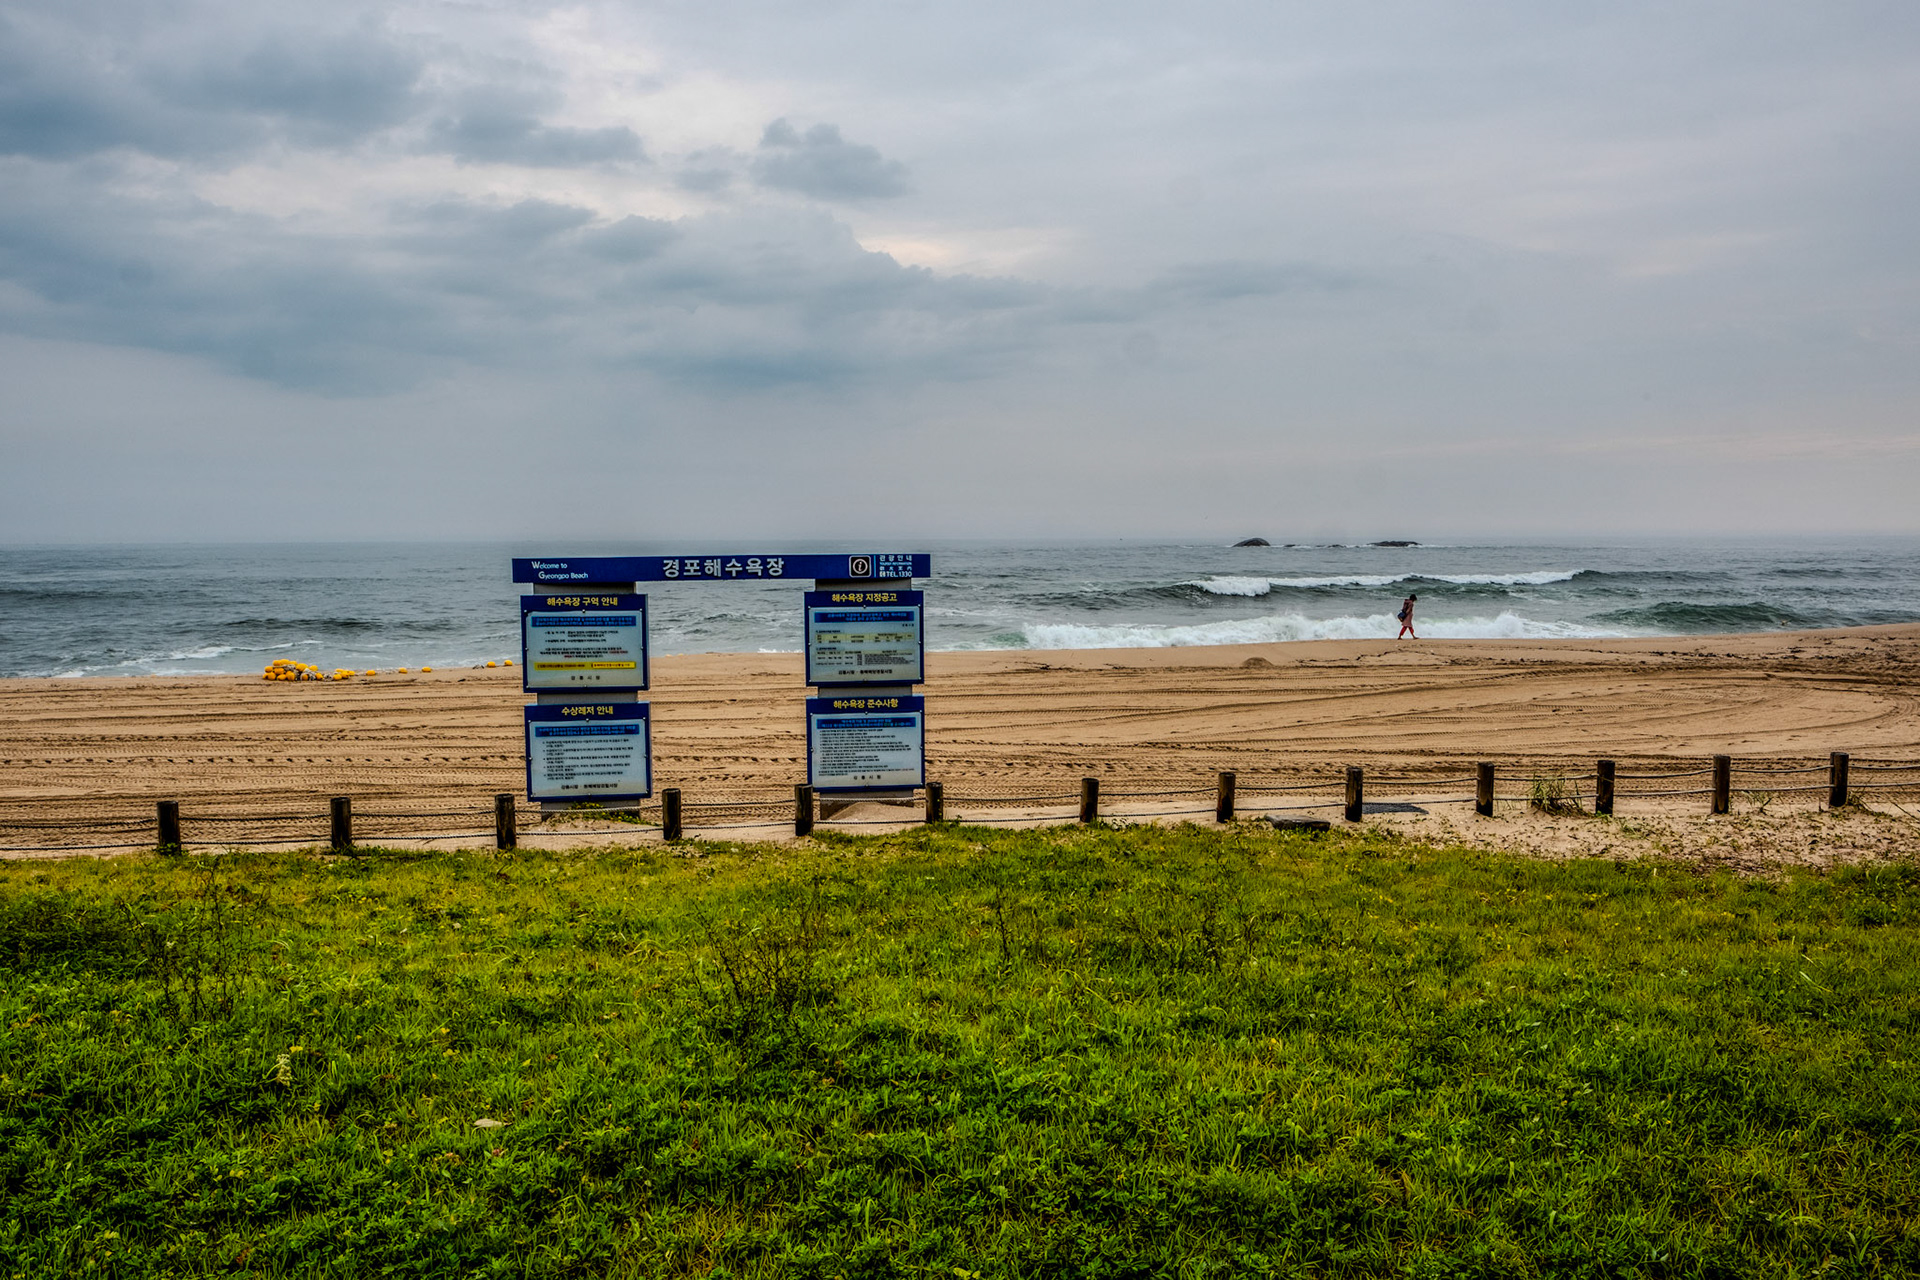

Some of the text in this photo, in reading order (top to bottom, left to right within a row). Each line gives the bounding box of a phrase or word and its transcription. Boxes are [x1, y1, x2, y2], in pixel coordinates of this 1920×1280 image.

[531, 561, 559, 569] Welcome
[663, 558, 785, 578] 경포해수욕장
[538, 571, 569, 580] Gyeongpo
[547, 597, 618, 607] 해수욕장 구역 안내
[831, 593, 898, 602] 해수욕장 지정공고
[833, 700, 865, 709] 해수욕장
[561, 706, 614, 716] 수상레저 안내
